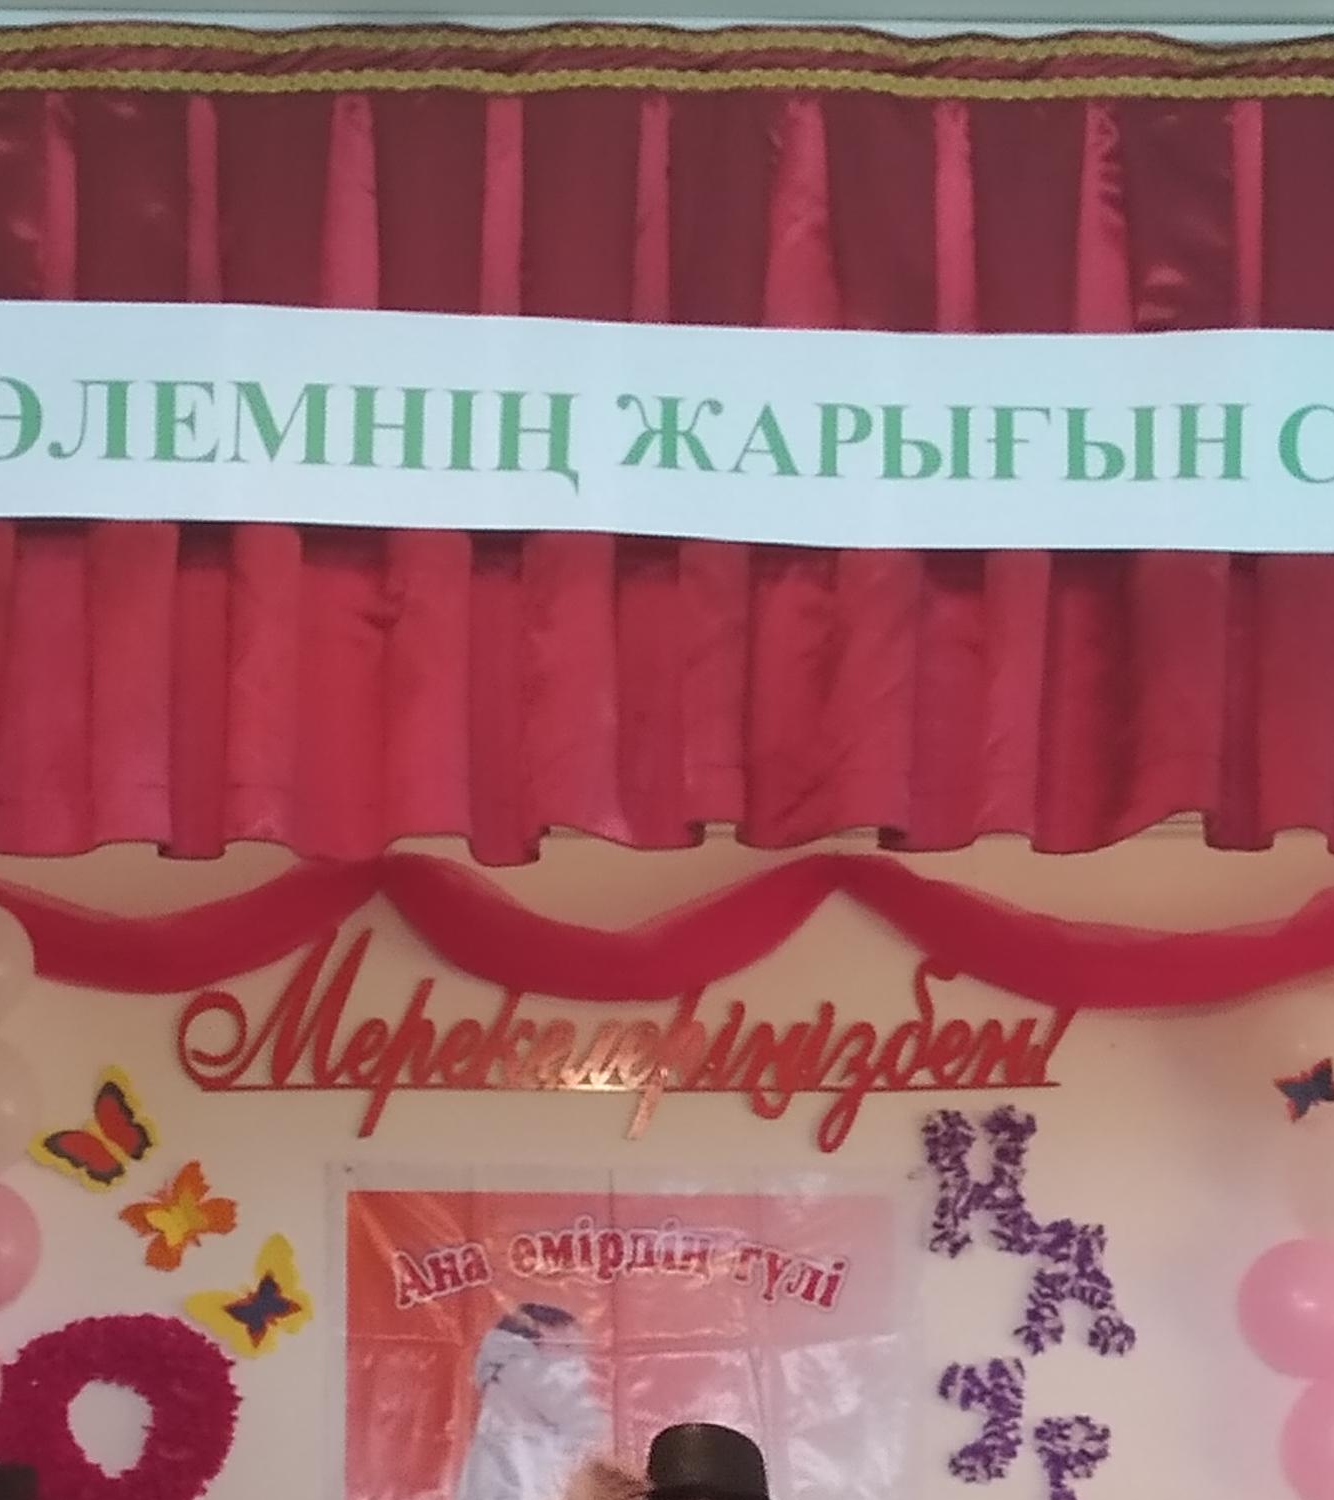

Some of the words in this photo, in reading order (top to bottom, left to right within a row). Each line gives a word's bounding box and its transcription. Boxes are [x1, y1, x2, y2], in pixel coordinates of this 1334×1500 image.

[615, 393, 1251, 483] ЖАРЫҒЫН
[396, 1244, 493, 1309] Ана
[733, 1240, 848, 1310] гүлі
